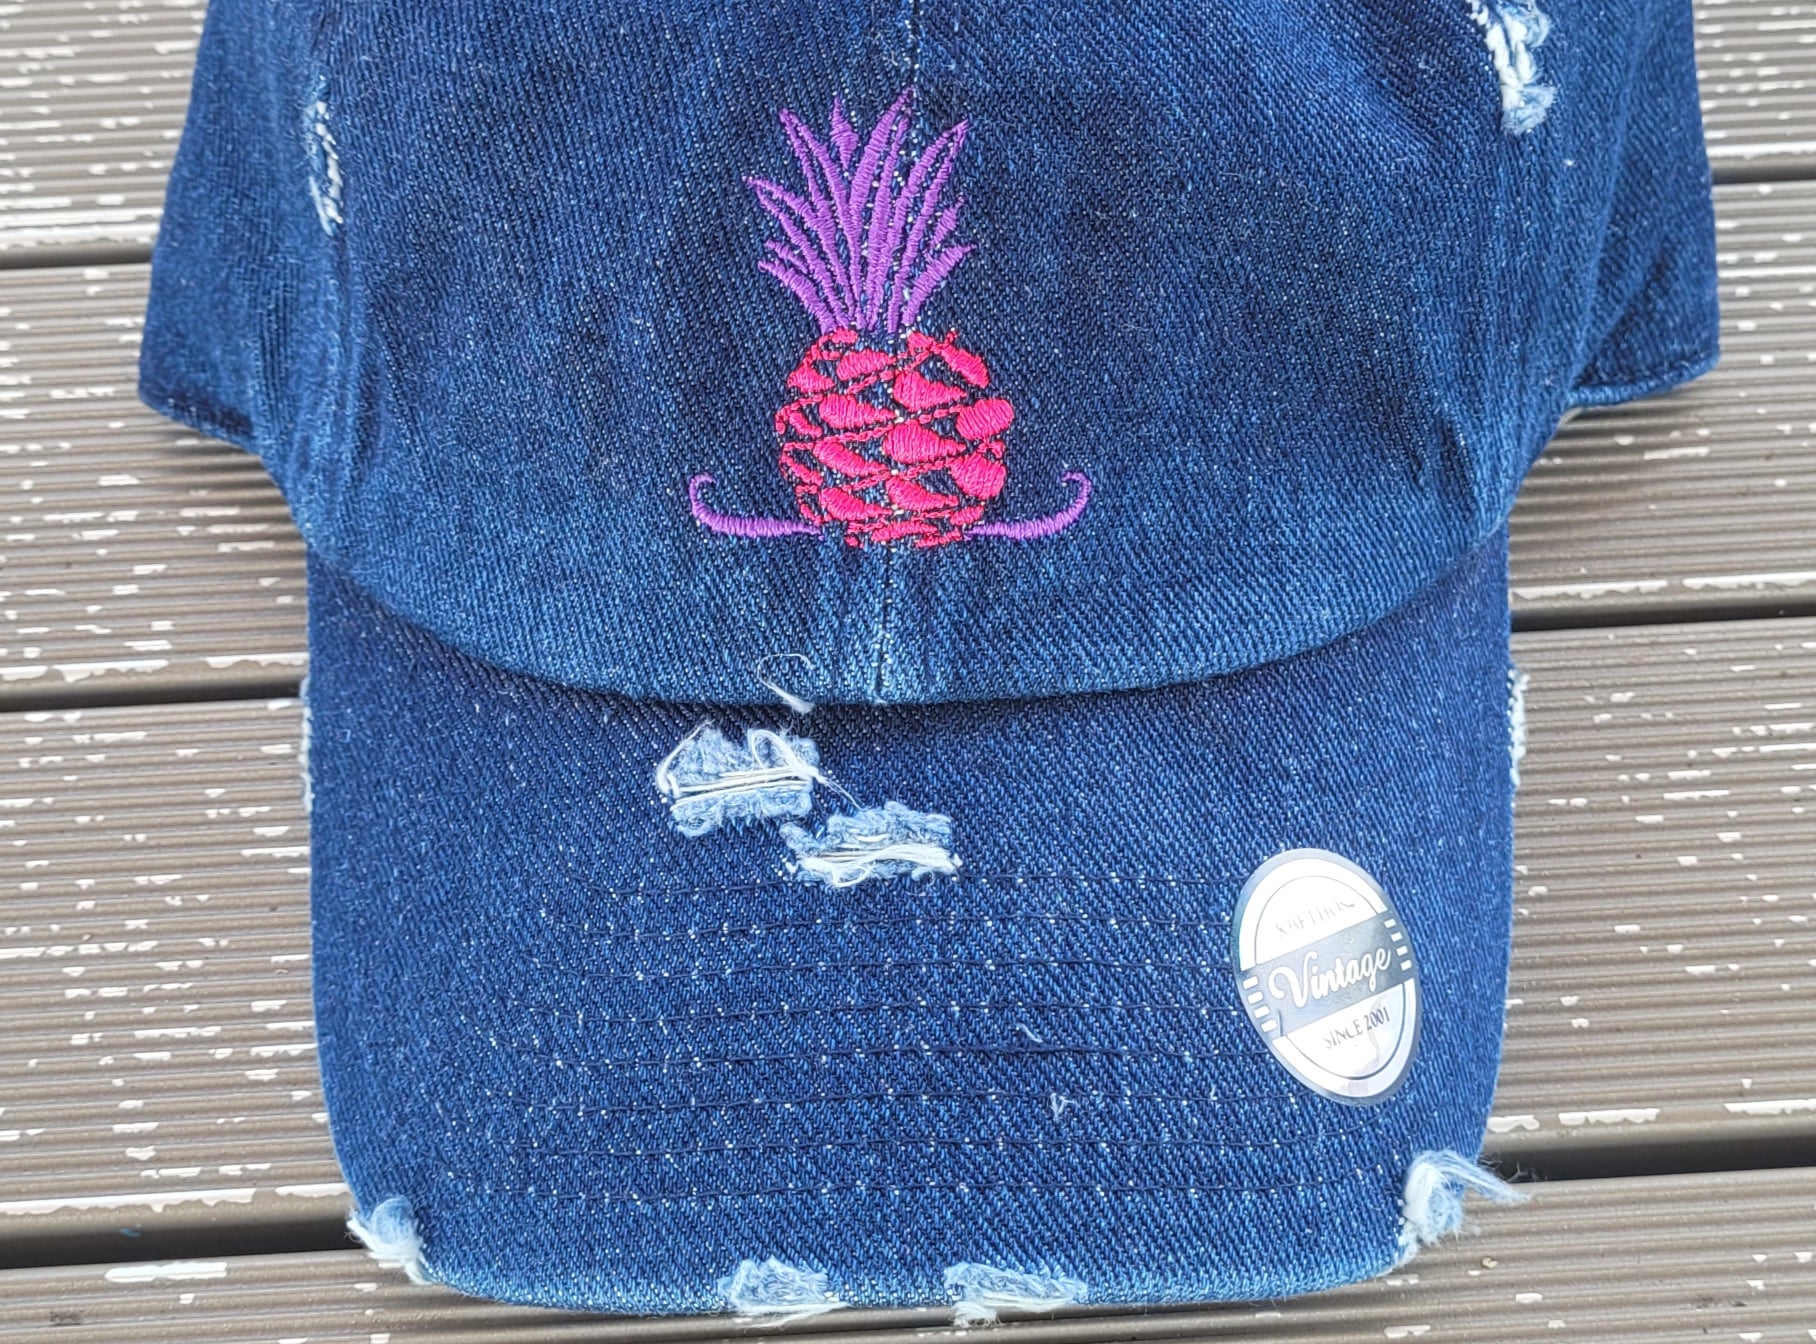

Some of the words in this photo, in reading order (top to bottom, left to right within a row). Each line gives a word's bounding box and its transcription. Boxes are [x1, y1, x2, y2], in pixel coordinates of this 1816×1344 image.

[1267, 947, 1391, 1008] Vintage
[1322, 1018, 1364, 1049] SINCE
[1363, 1006, 1390, 1031] 2001
